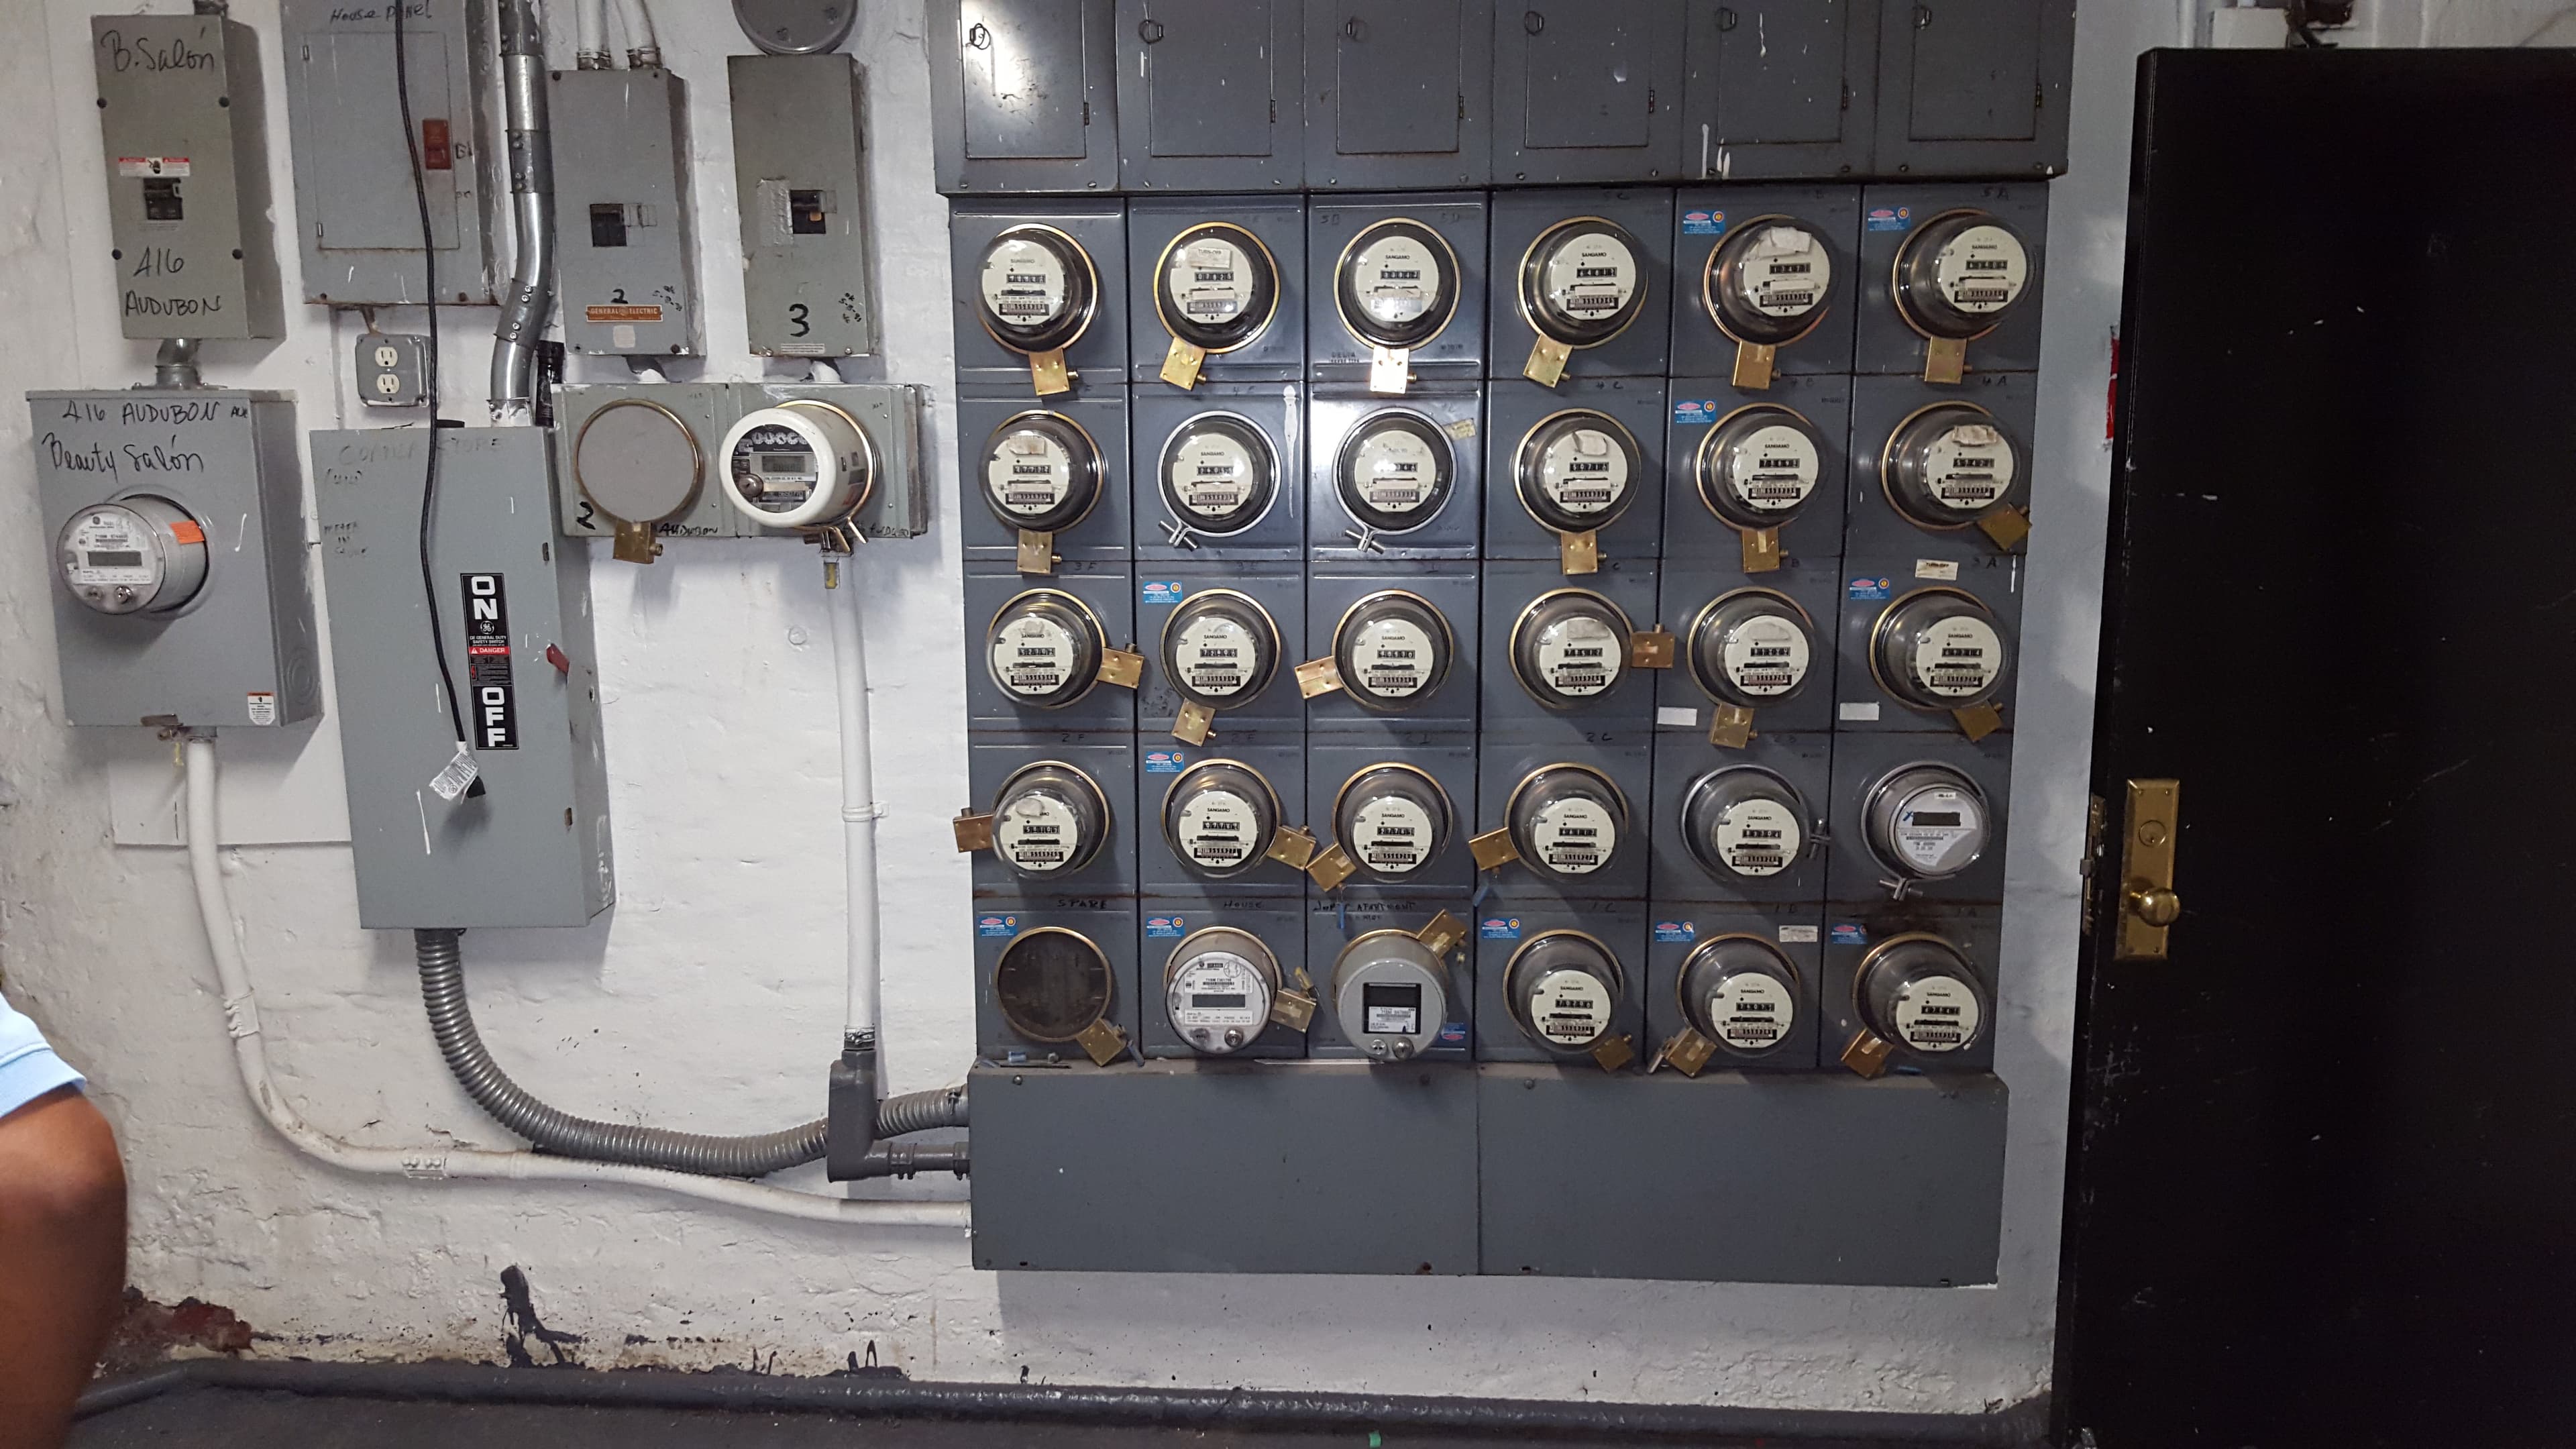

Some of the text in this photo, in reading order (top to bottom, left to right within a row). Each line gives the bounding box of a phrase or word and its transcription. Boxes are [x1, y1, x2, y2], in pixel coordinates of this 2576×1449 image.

[133, 246, 184, 278] 416
[125, 290, 221, 317] AUDUBON
[610, 288, 629, 305] 2
[789, 303, 810, 338] 3
[63, 400, 105, 423] 416
[123, 401, 220, 424] AUDUBON
[576, 501, 596, 530] 2
[471, 575, 498, 620] ON
[482, 687, 506, 747] OFF
[1057, 899, 1107, 910] SPARE
